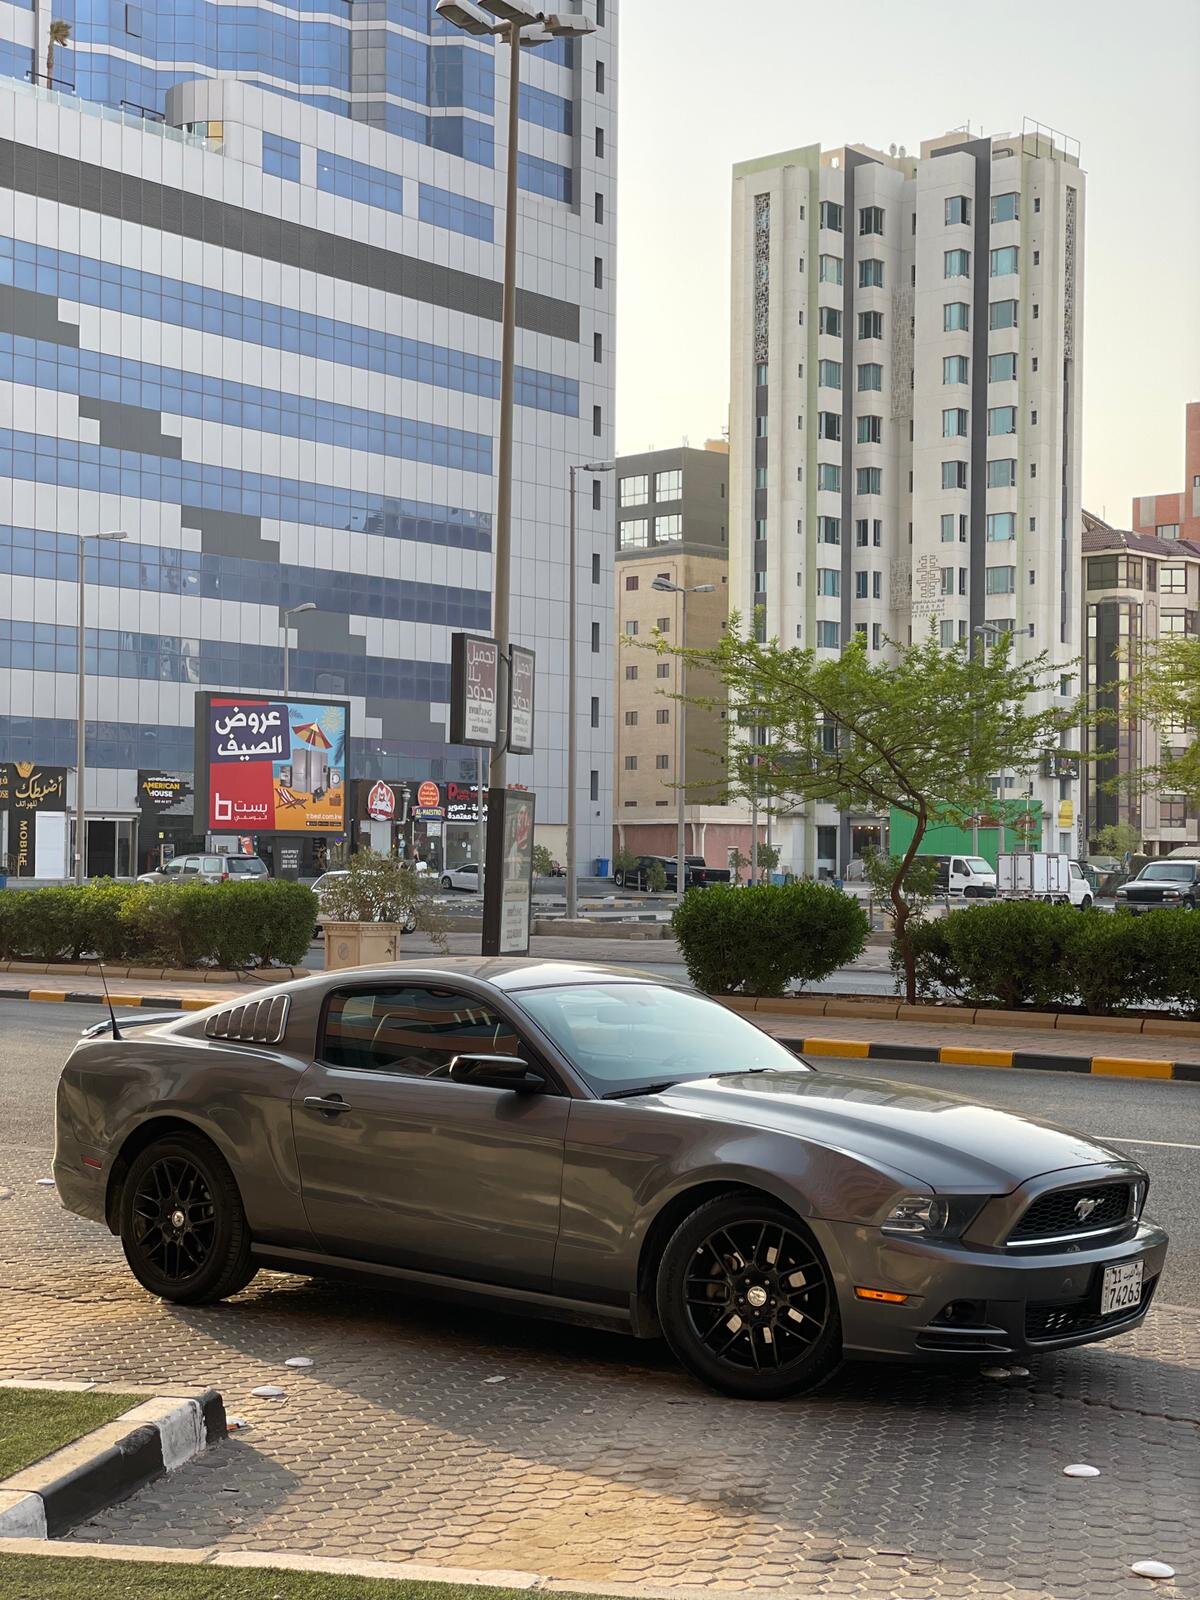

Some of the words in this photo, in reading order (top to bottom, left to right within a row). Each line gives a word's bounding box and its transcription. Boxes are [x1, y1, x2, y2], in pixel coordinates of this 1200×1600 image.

[468, 645, 495, 667] تجميل
[468, 666, 482, 686] بلا
[467, 684, 494, 702] حدود
[215, 706, 281, 735] عروض
[217, 733, 283, 761] الصيف
[142, 782, 180, 790] AMERICAN
[149, 790, 173, 798] HOUSE
[234, 800, 268, 815] بست
[20, 821, 28, 867] MOBILE
[1110, 1281, 1140, 1308] 74263
